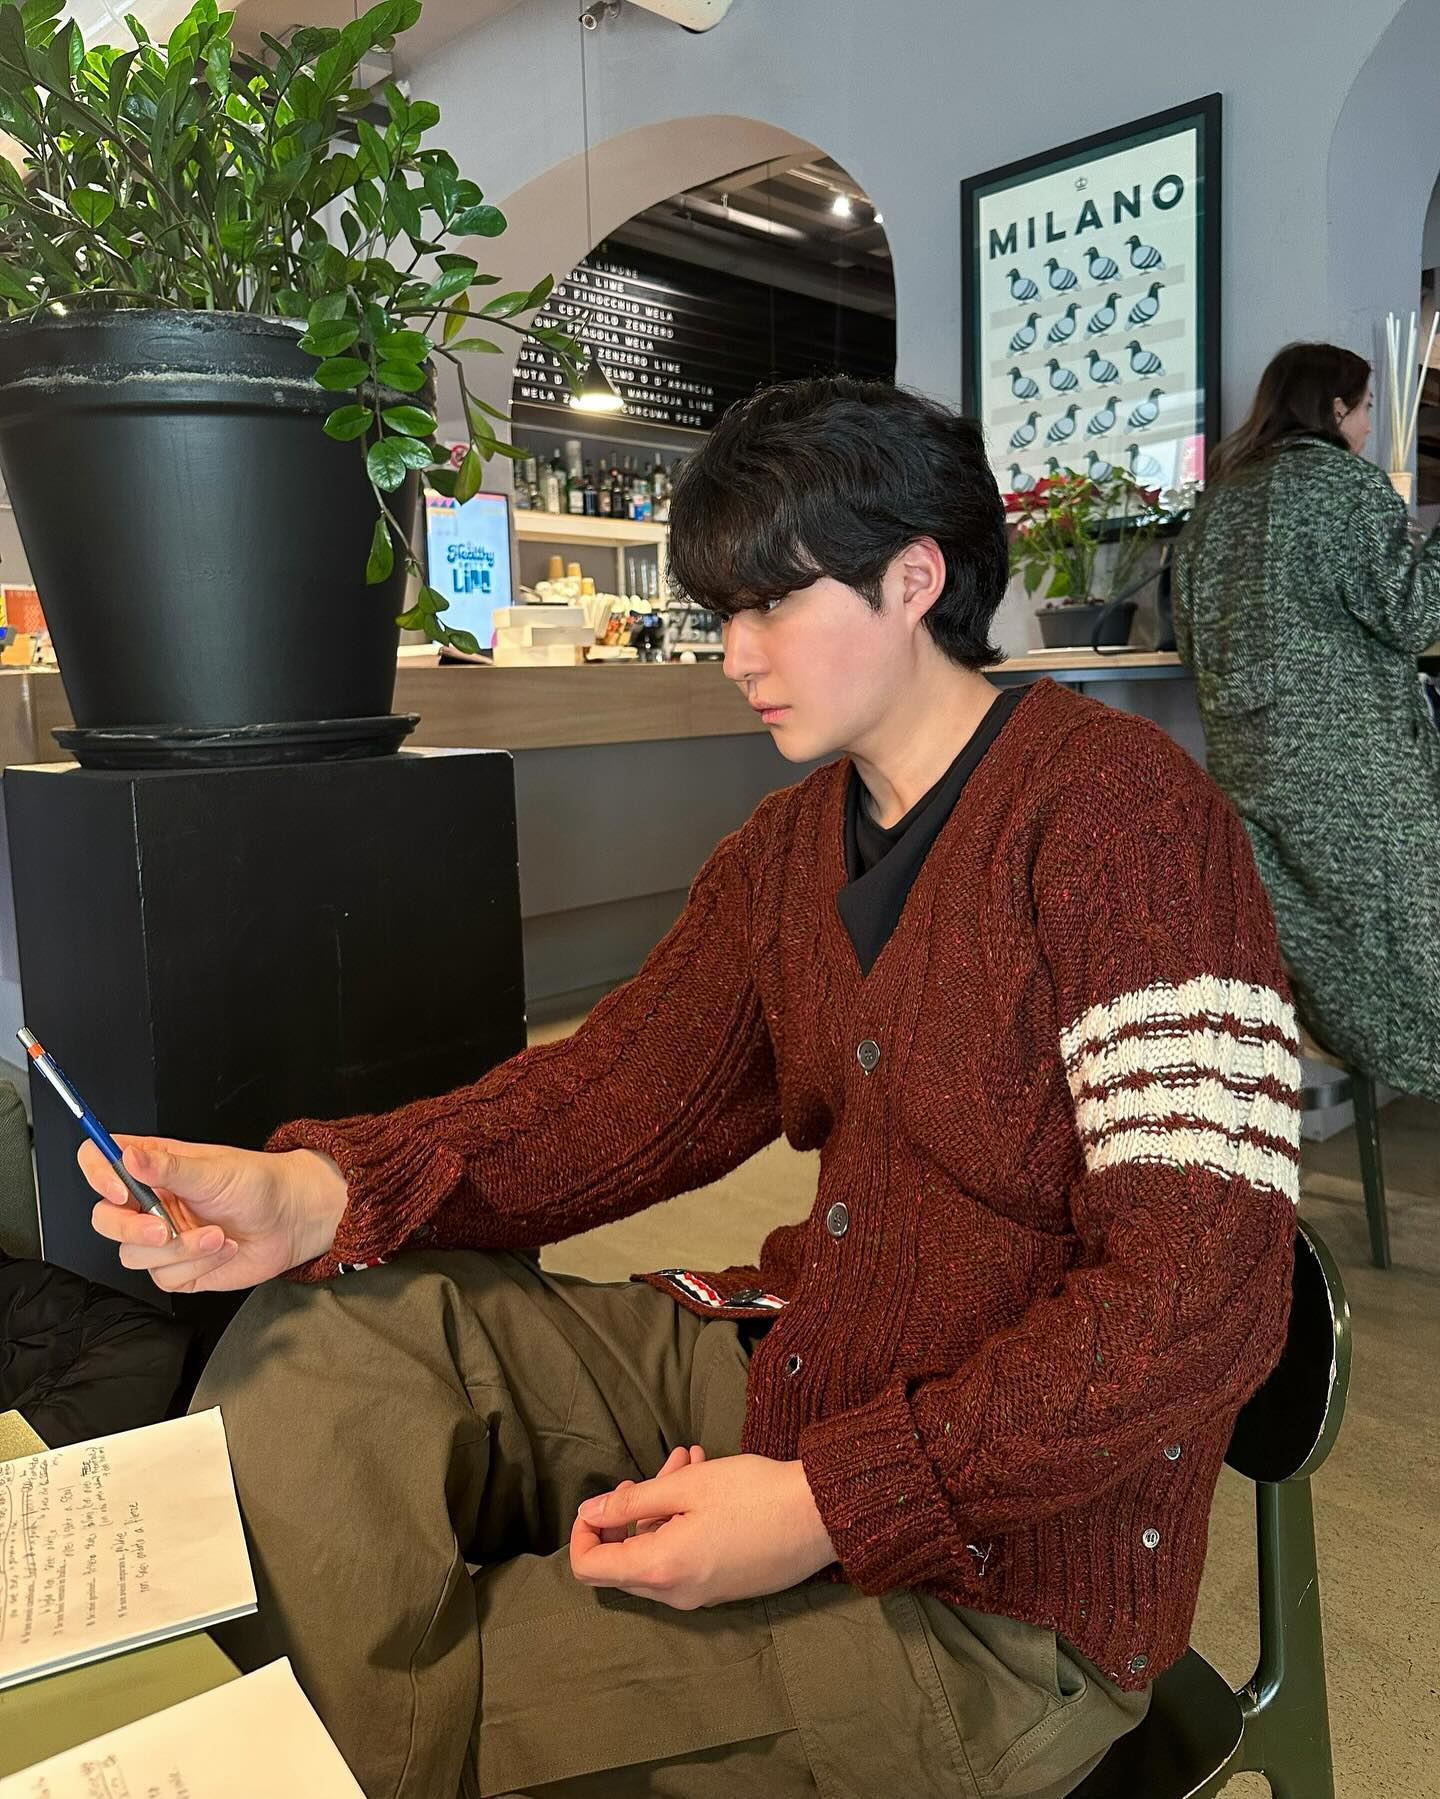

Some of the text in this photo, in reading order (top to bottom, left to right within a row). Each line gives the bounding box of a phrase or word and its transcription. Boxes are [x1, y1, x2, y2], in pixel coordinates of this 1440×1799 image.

[989, 174, 1184, 259] MILANO
[574, 288, 640, 314] FINOCCHIO
[558, 303, 619, 326] CETOLO
[625, 319, 674, 339] ZENZERO
[598, 348, 648, 367] ZENZERO
[675, 413, 701, 426] PEPE
